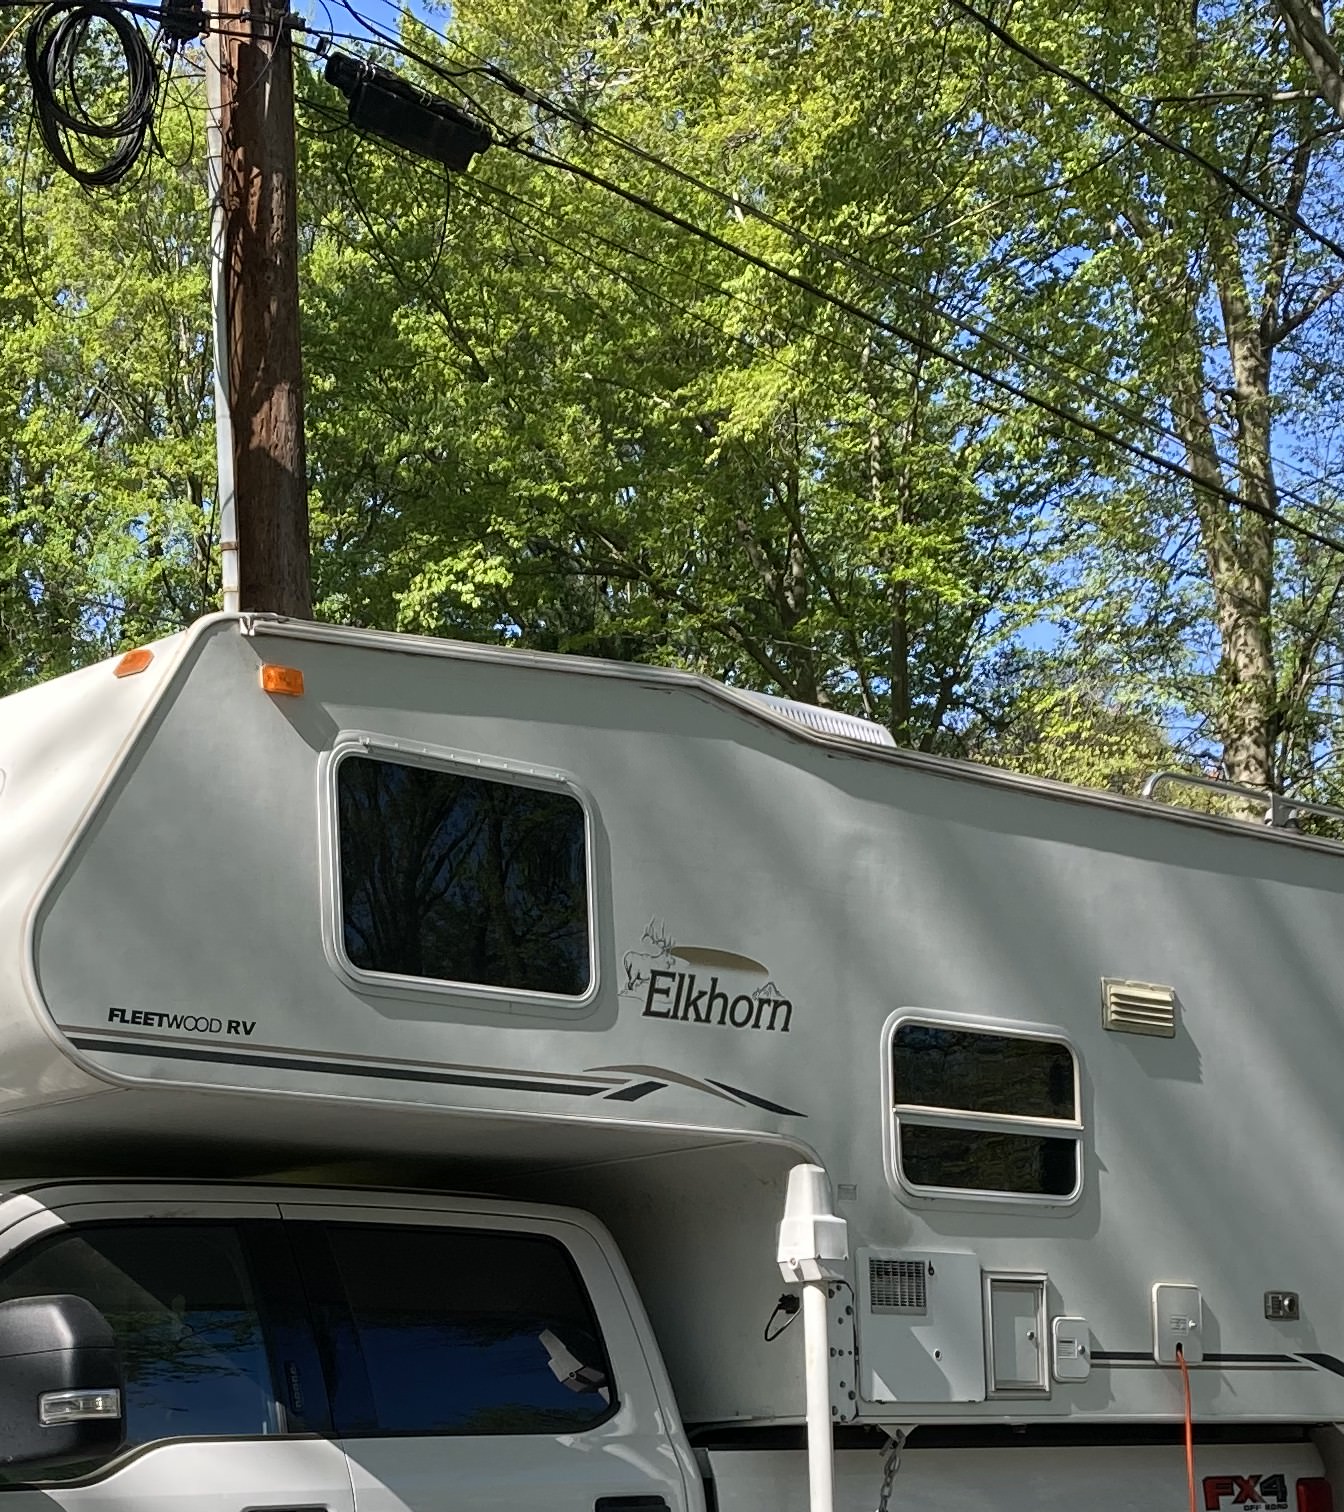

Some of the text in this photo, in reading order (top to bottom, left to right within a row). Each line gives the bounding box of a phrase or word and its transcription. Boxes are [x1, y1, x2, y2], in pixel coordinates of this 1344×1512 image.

[642, 969, 793, 1032] Elkhorn
[108, 1007, 257, 1036] FLEETWOOD RV
[1202, 1473, 1288, 1512] FX4
